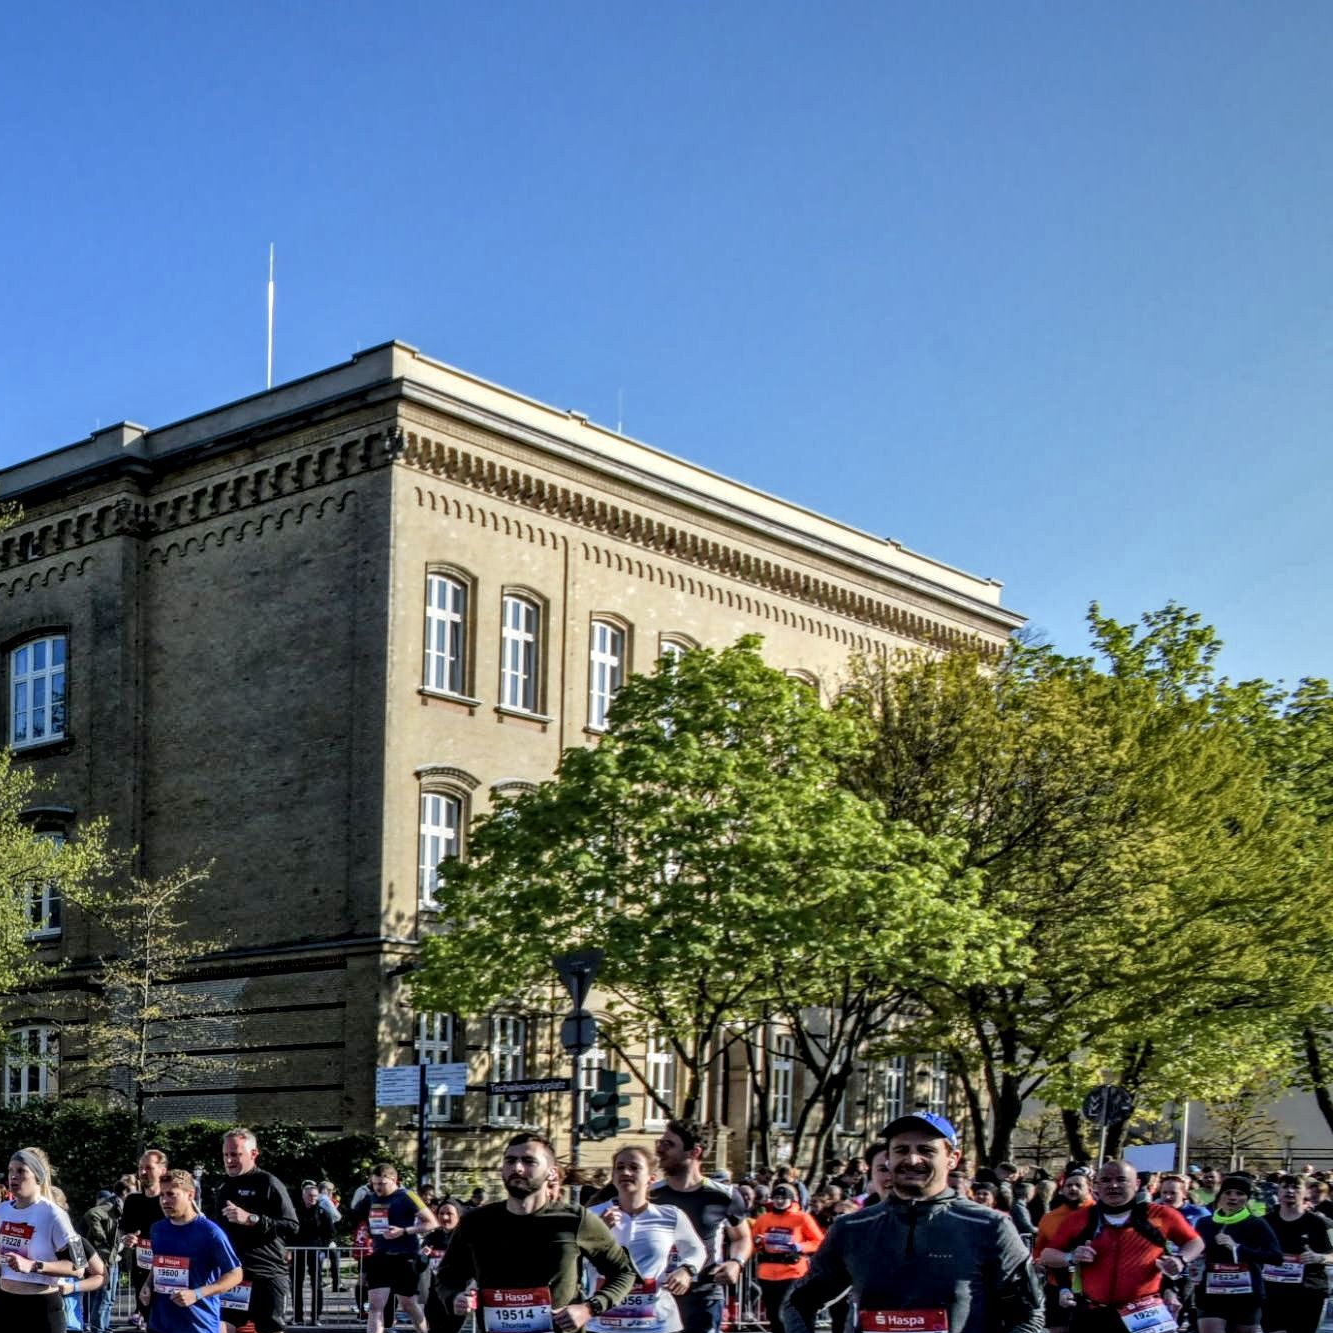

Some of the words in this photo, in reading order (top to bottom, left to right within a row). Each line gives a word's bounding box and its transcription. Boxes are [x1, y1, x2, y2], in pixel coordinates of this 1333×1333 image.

[504, 1293, 534, 1303] Haspa
[495, 1308, 535, 1321] 19514
[888, 1315, 925, 1327] Haspa
